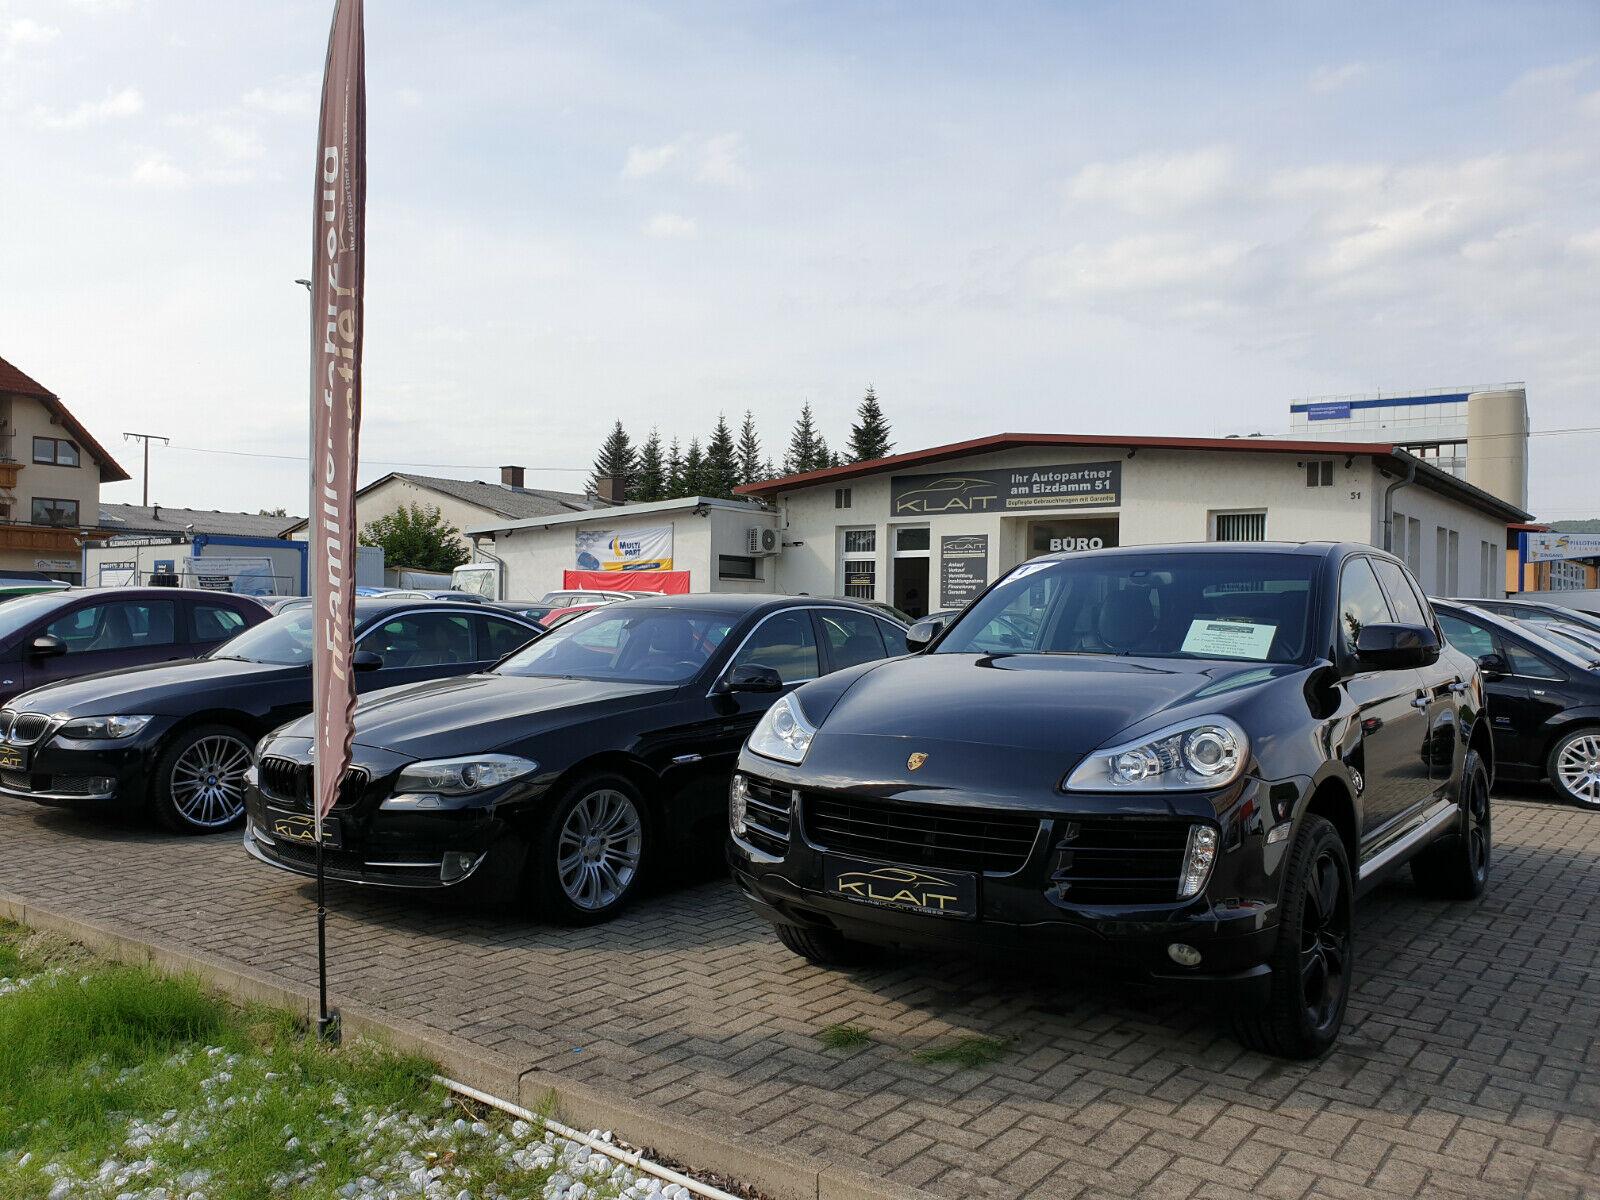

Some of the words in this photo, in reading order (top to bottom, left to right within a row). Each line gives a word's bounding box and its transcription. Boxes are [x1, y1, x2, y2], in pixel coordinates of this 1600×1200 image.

[343, 168, 354, 233] Autopartner
[1011, 474, 1028, 483] Ihr
[1031, 470, 1112, 482] Autopartner
[1010, 486, 1029, 495] am
[1032, 483, 1091, 494] Elzdamm
[1094, 480, 1110, 490] 51
[1350, 491, 1361, 500] 51
[896, 495, 998, 513] KLAIT
[1049, 537, 1103, 551] BÜRO
[0, 756, 22, 766] AIT
[274, 823, 334, 841] KLA
[838, 877, 958, 910] KLAIT
